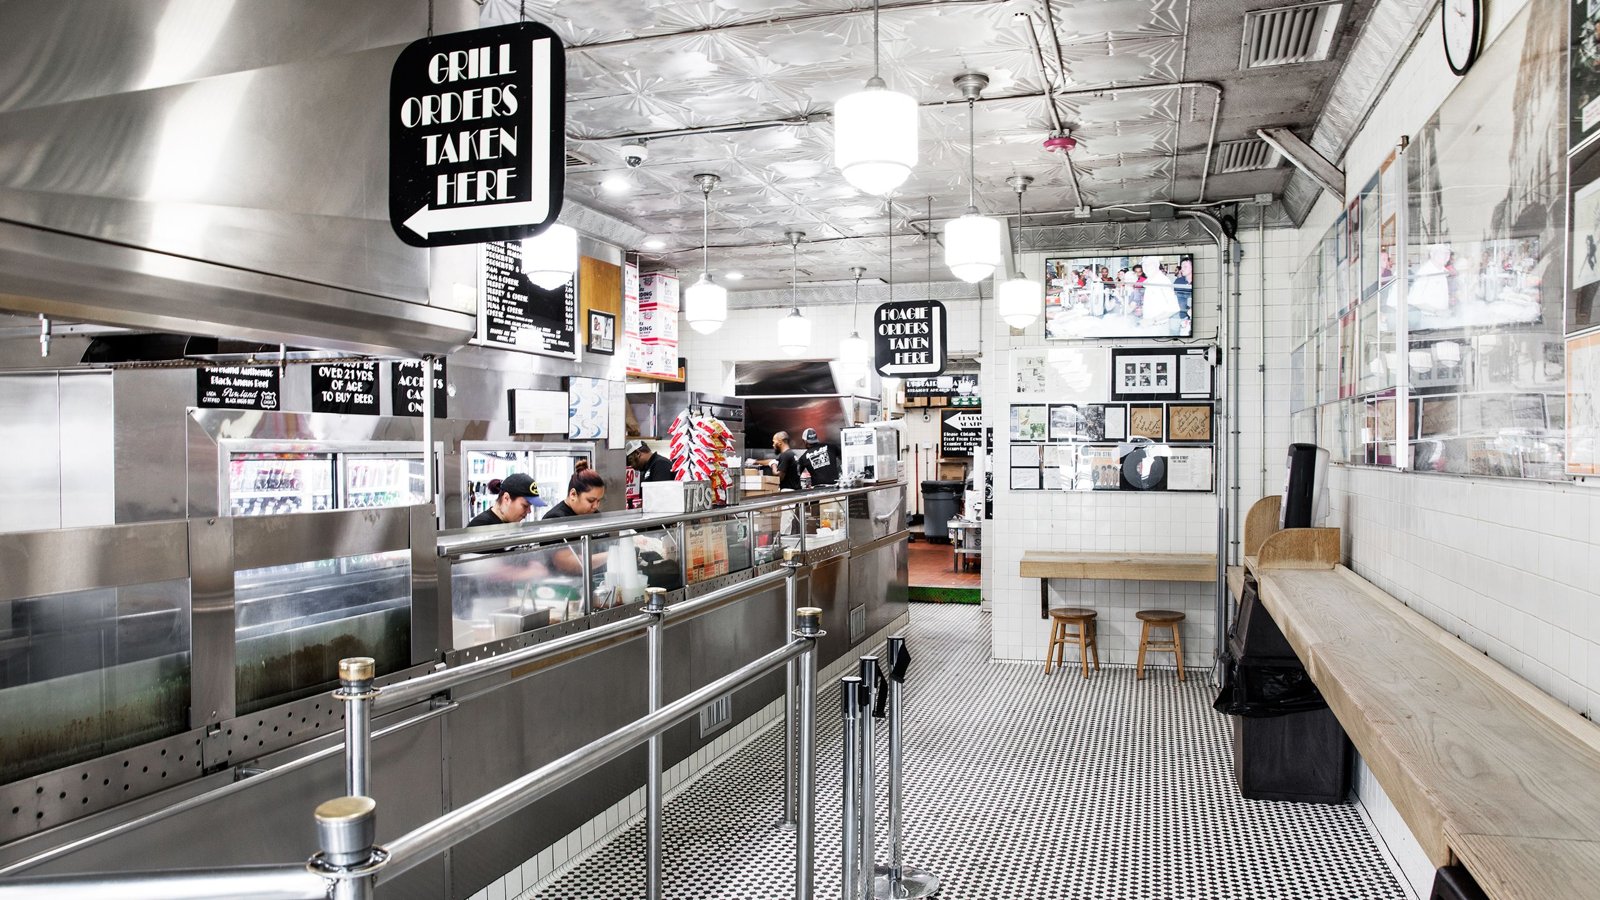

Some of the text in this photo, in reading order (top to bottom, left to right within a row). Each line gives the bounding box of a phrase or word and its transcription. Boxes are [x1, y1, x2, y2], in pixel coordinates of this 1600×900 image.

[428, 43, 517, 84] GRILL
[400, 84, 518, 128] ORDERS
[421, 126, 517, 166] TAKEN
[436, 167, 517, 206] HERE
[881, 307, 928, 320] HOAGIE
[879, 322, 929, 336] ORDERS
[888, 337, 929, 350] TAKEN
[895, 352, 929, 364] HERE
[240, 367, 274, 377] Authentic
[319, 366, 343, 379] OVER
[344, 369, 355, 380] 21
[211, 375, 270, 389] Black Angus Beef
[331, 380, 363, 392] OF AGE
[398, 375, 443, 389] ACCETS
[322, 391, 374, 404] TO BUY BEER
[408, 402, 424, 413] ON
[684, 483, 712, 512] TIPS
